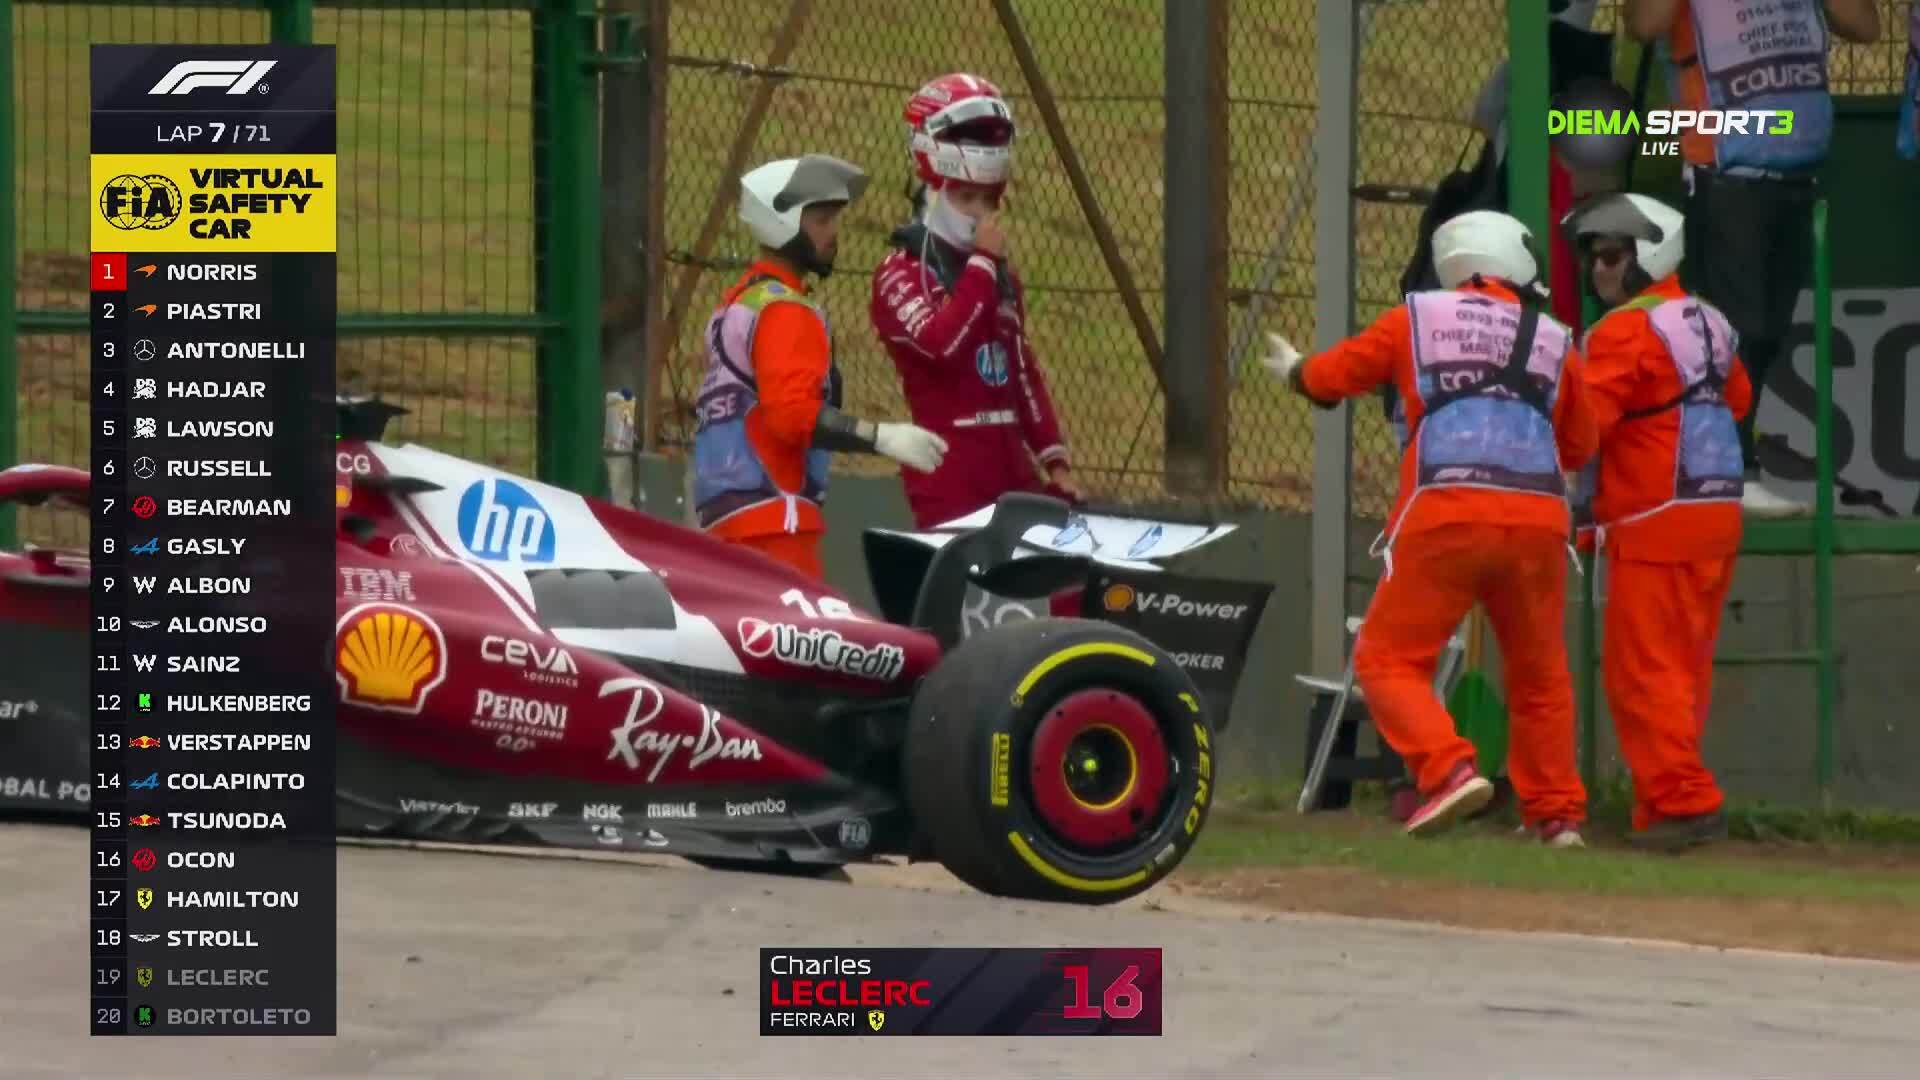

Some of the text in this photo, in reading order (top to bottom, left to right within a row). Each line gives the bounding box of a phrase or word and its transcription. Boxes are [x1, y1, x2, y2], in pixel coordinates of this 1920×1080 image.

[472, 478, 547, 563] hp
[340, 568, 416, 601] IBM
[1136, 591, 1248, 619] V-Power
[775, 624, 904, 681] UniCredit
[475, 688, 568, 729] PERONI
[584, 803, 624, 822] NGK
[725, 798, 787, 818] brembo
